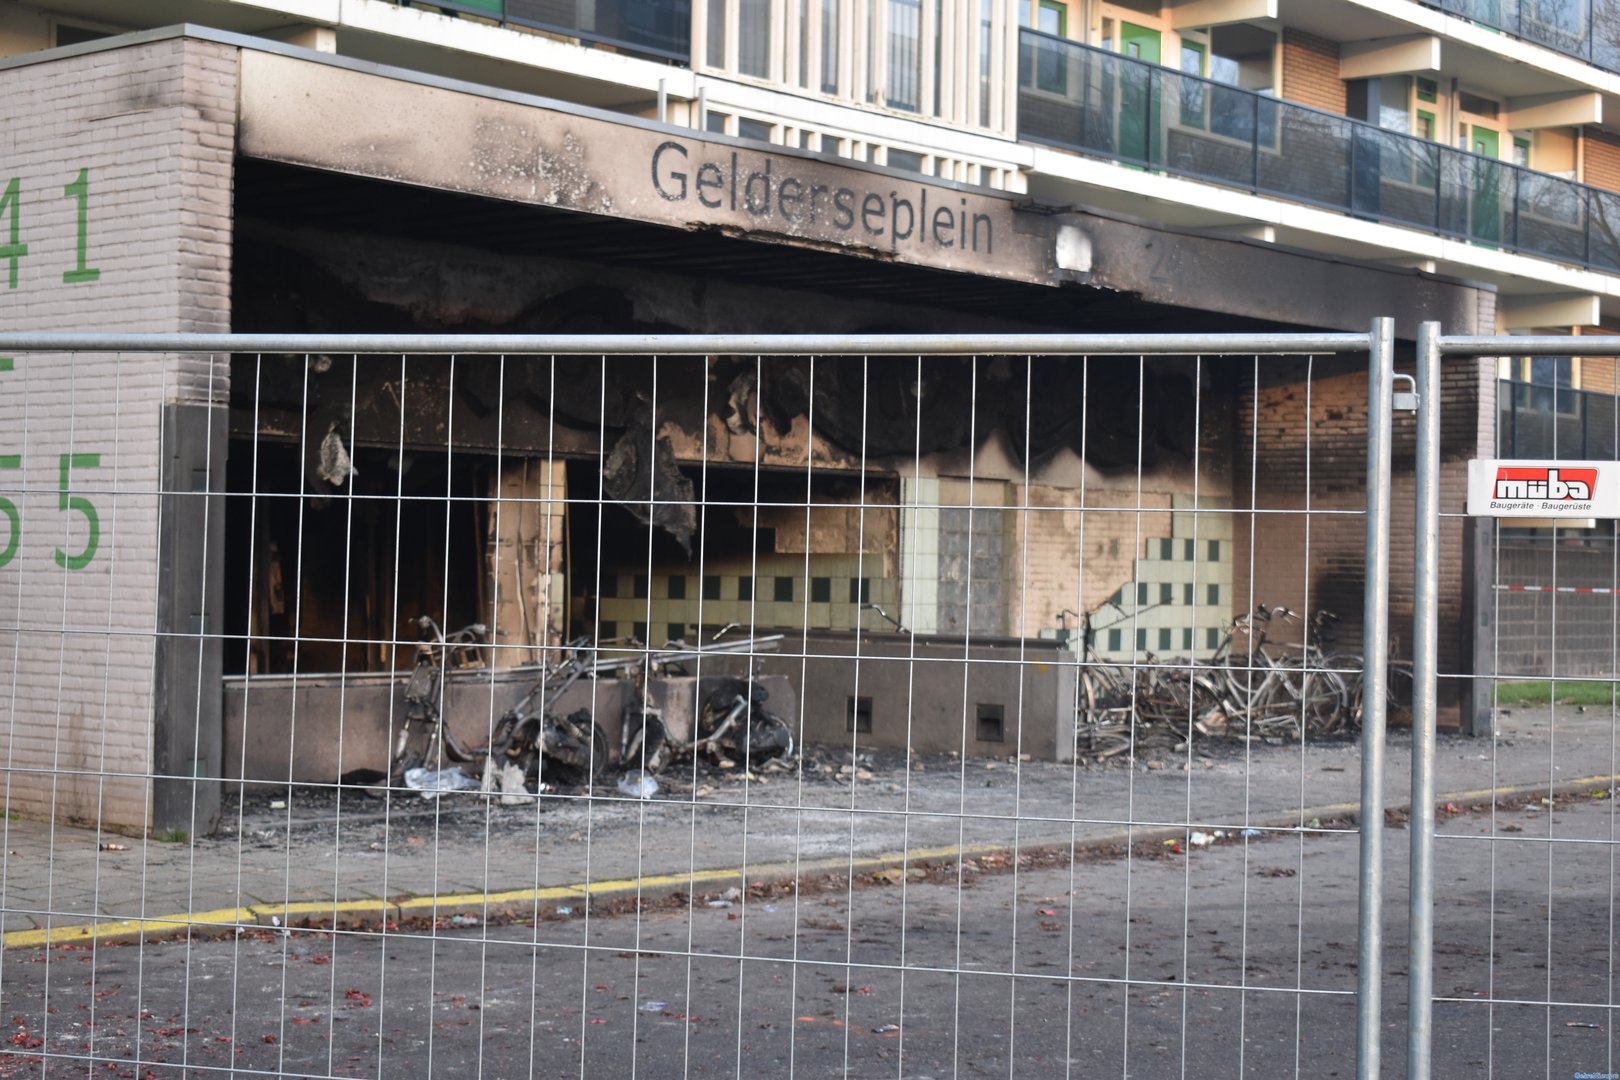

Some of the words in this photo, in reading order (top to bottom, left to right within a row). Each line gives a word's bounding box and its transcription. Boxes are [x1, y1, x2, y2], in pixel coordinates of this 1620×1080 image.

[651, 141, 992, 255] Gelderseplein
[1496, 468, 1590, 500] müba
[1489, 501, 1534, 510] Baugeräte
[1541, 502, 1591, 511] Baugerüste
